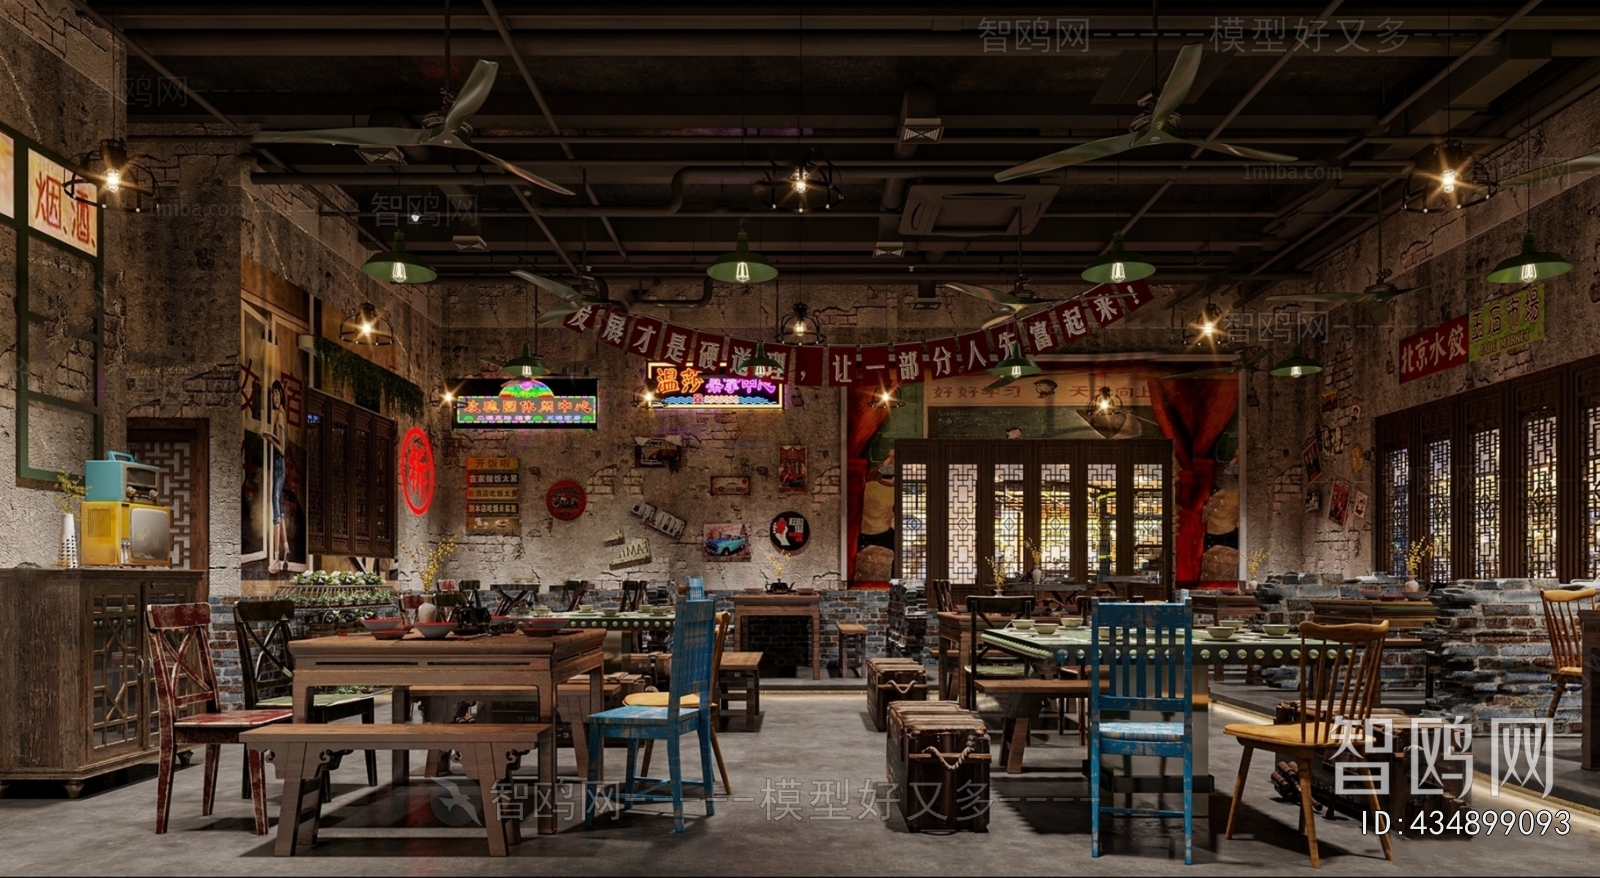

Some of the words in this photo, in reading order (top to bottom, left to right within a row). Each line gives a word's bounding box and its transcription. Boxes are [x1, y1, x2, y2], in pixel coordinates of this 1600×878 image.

[1480, 342, 1498, 356] JADE
[1500, 328, 1531, 351] MARKET
[1068, 385, 1150, 399] 天向上
[469, 474, 518, 483] 在家做饭太累
